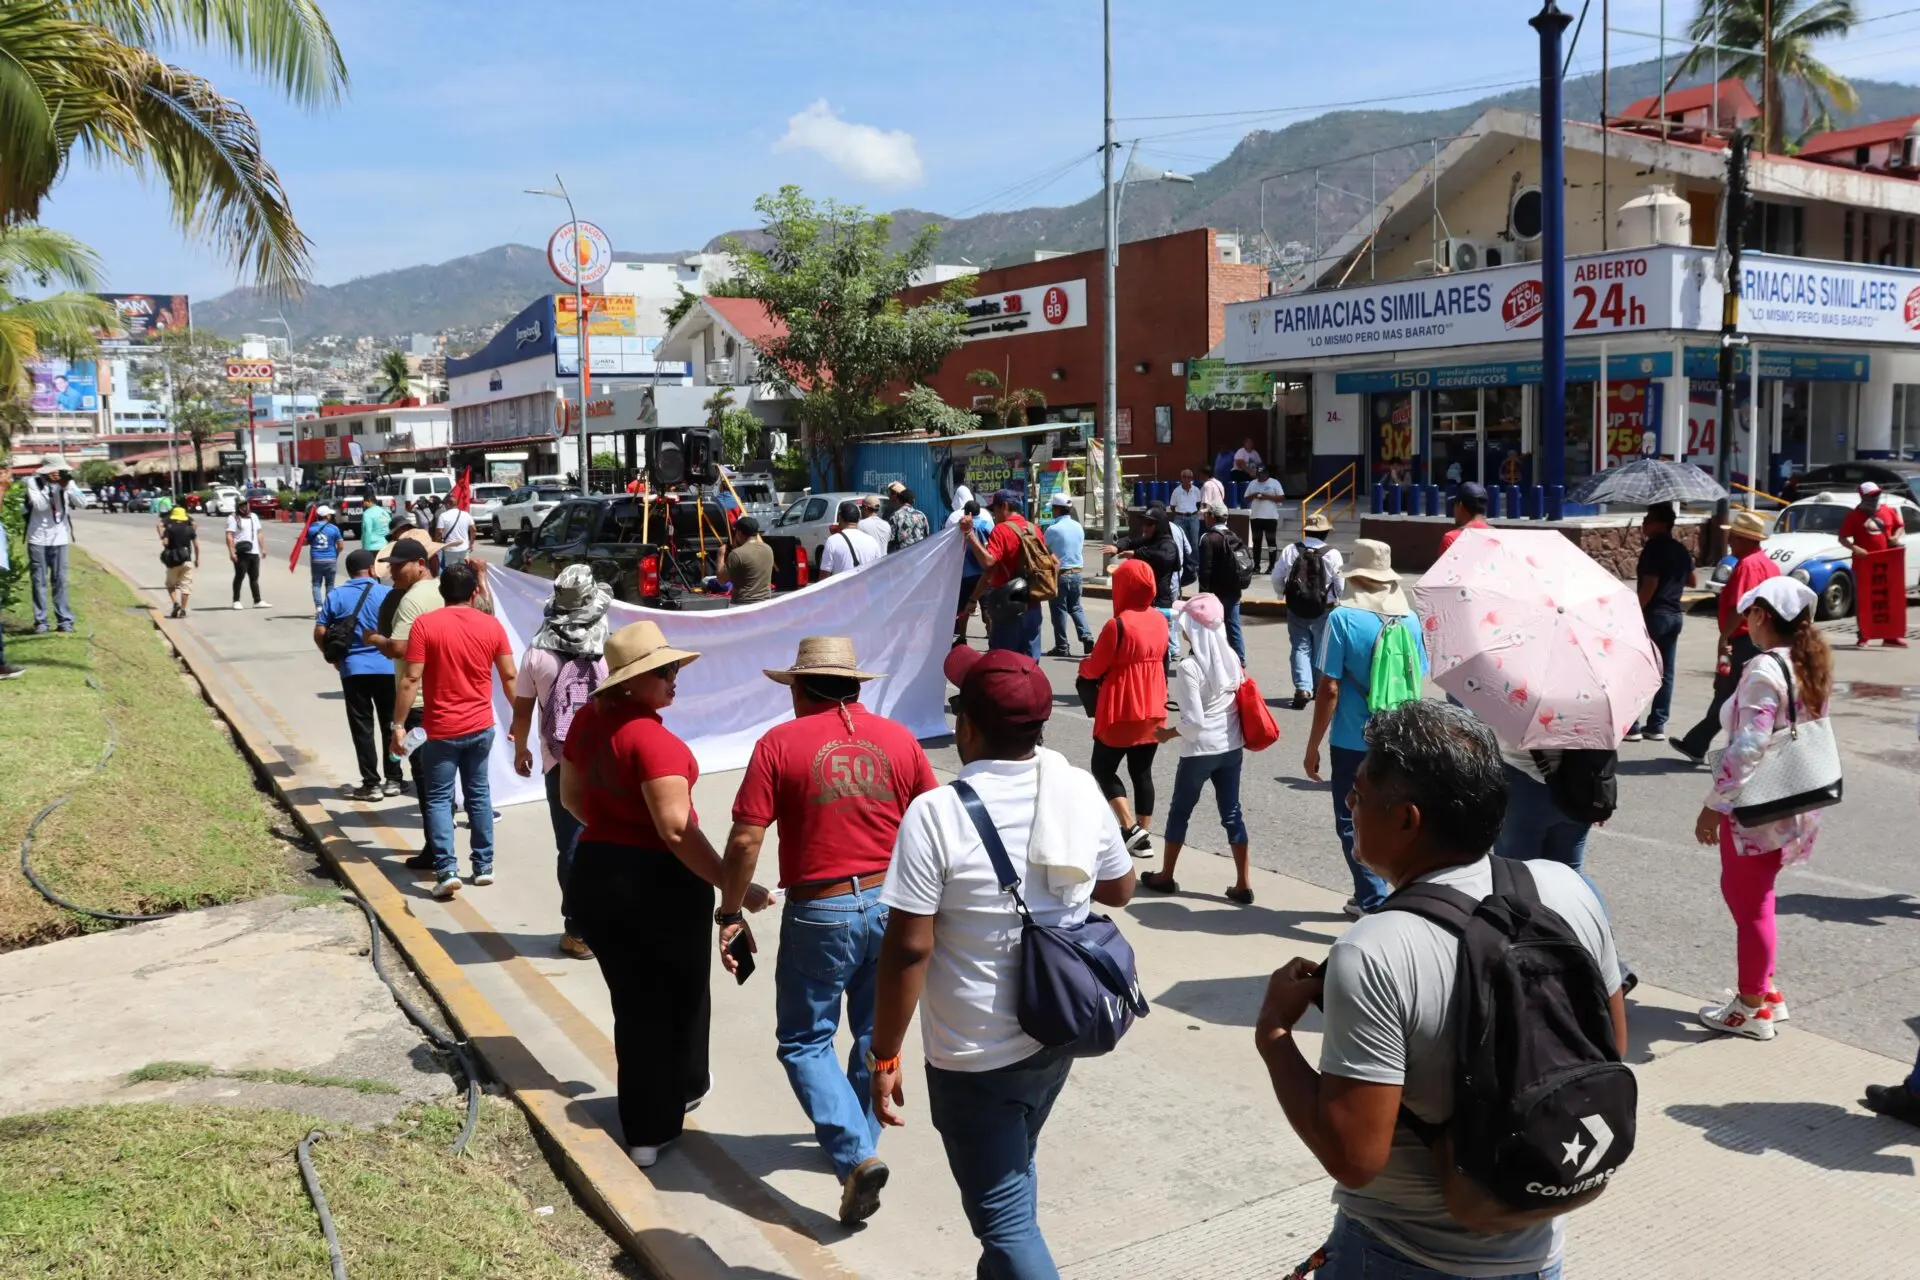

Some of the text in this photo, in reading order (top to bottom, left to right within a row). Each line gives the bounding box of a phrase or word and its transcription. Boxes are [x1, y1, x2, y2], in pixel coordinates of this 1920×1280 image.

[1574, 258, 1647, 282] ABIERTO
[1050, 290, 1057, 304] B
[1737, 269, 1816, 306] ARMACIAS
[1819, 276, 1897, 311] SIMILARES
[1275, 298, 1376, 333] FARMACIAS
[1381, 283, 1492, 323] SIMILARES
[1508, 285, 1541, 316] 75%
[1046, 303, 1061, 318] BB
[1766, 310, 1794, 321] MISMO
[1797, 311, 1819, 324] PERO
[1324, 332, 1353, 345] MISMO
[1355, 330, 1380, 343] PERO
[1382, 328, 1403, 340] MAS
[228, 364, 271, 377] OXXO
[1390, 371, 1430, 388] 150
[1326, 411, 1337, 422] 24
[831, 754, 875, 784] 50
[1526, 1167, 1616, 1197] CONVERS
